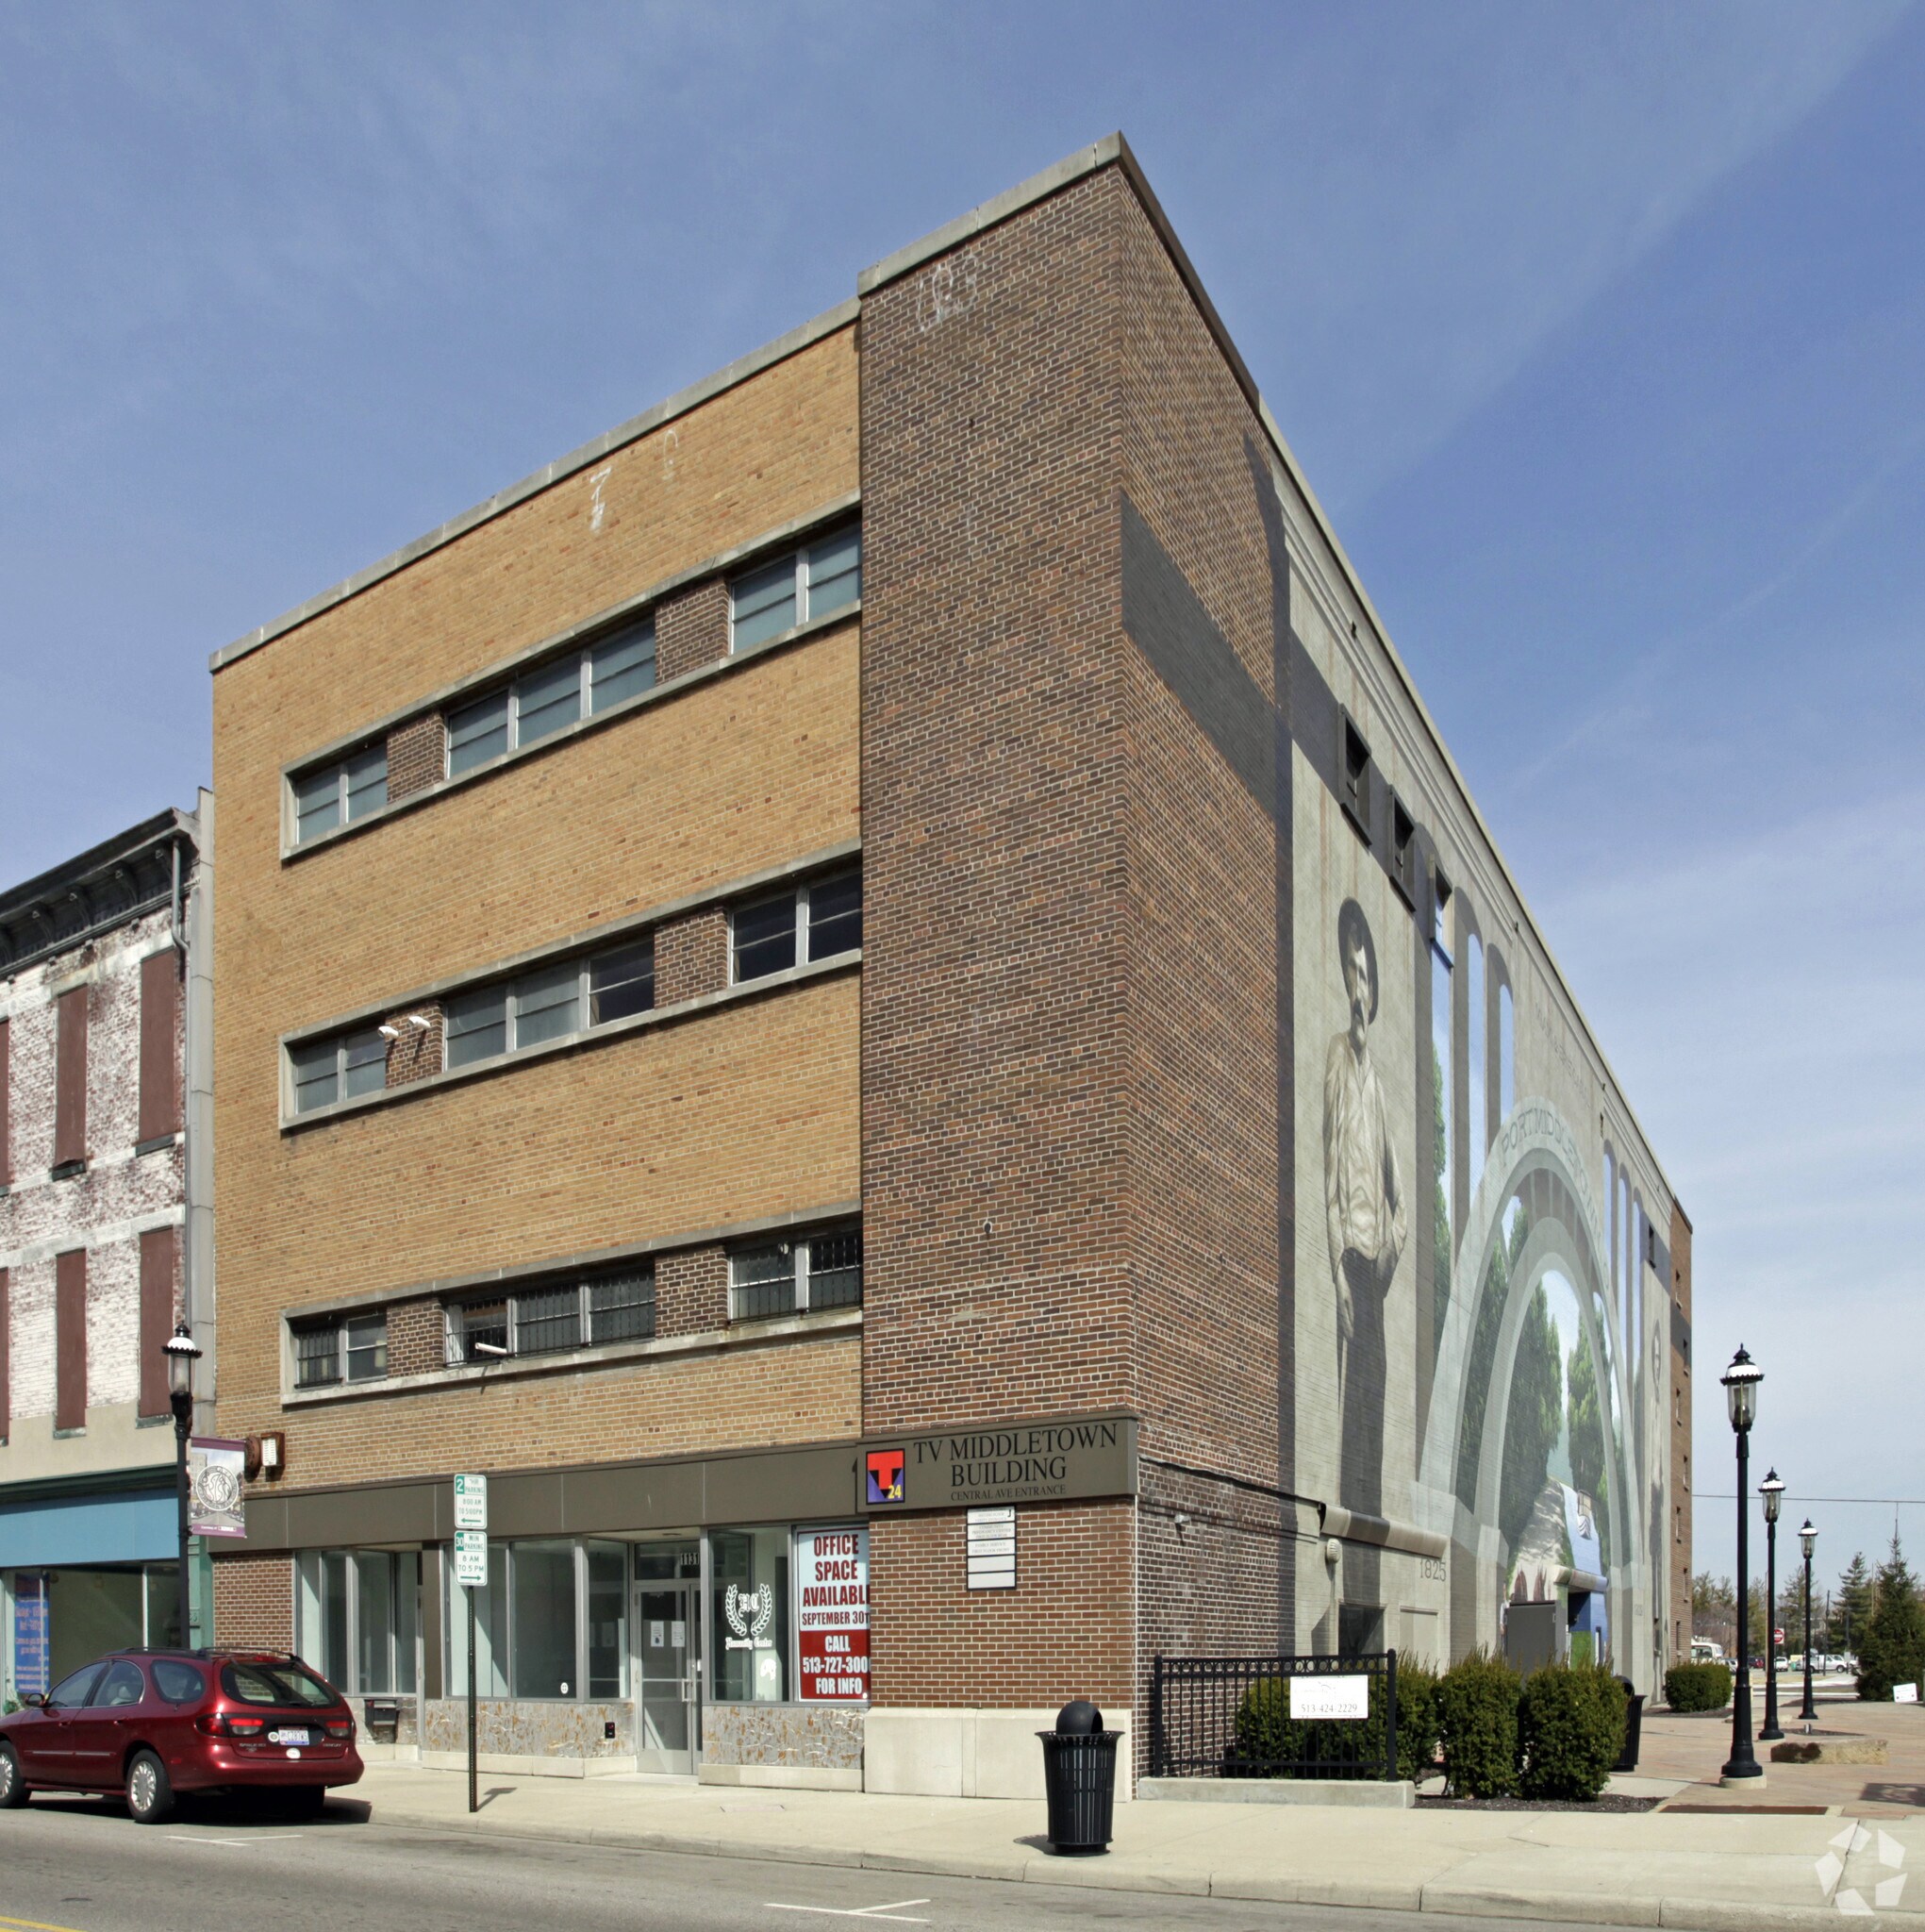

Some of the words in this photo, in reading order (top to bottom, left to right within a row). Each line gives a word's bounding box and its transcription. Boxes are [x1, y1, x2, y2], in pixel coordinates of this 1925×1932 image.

[914, 1440, 942, 1464] TV
[950, 1424, 1117, 1460] MIDDLETOWN
[951, 1456, 1067, 1488] BUILDING
[456, 1478, 463, 1491] 2
[888, 1484, 902, 1499] 24
[951, 1489, 993, 1501] CENTRAL
[995, 1488, 1013, 1498] AVE
[1015, 1484, 1066, 1497] ENTRANCE
[814, 1534, 859, 1557] OFFICE
[681, 1553, 699, 1565] 1131
[815, 1559, 858, 1581] SPACE
[1419, 1559, 1447, 1582] 1825
[802, 1612, 851, 1625] SEPTEMBER
[754, 1637, 772, 1648] Center
[824, 1635, 851, 1653] CALL
[815, 1678, 836, 1694] FOR
[838, 1677, 863, 1694] INFO
